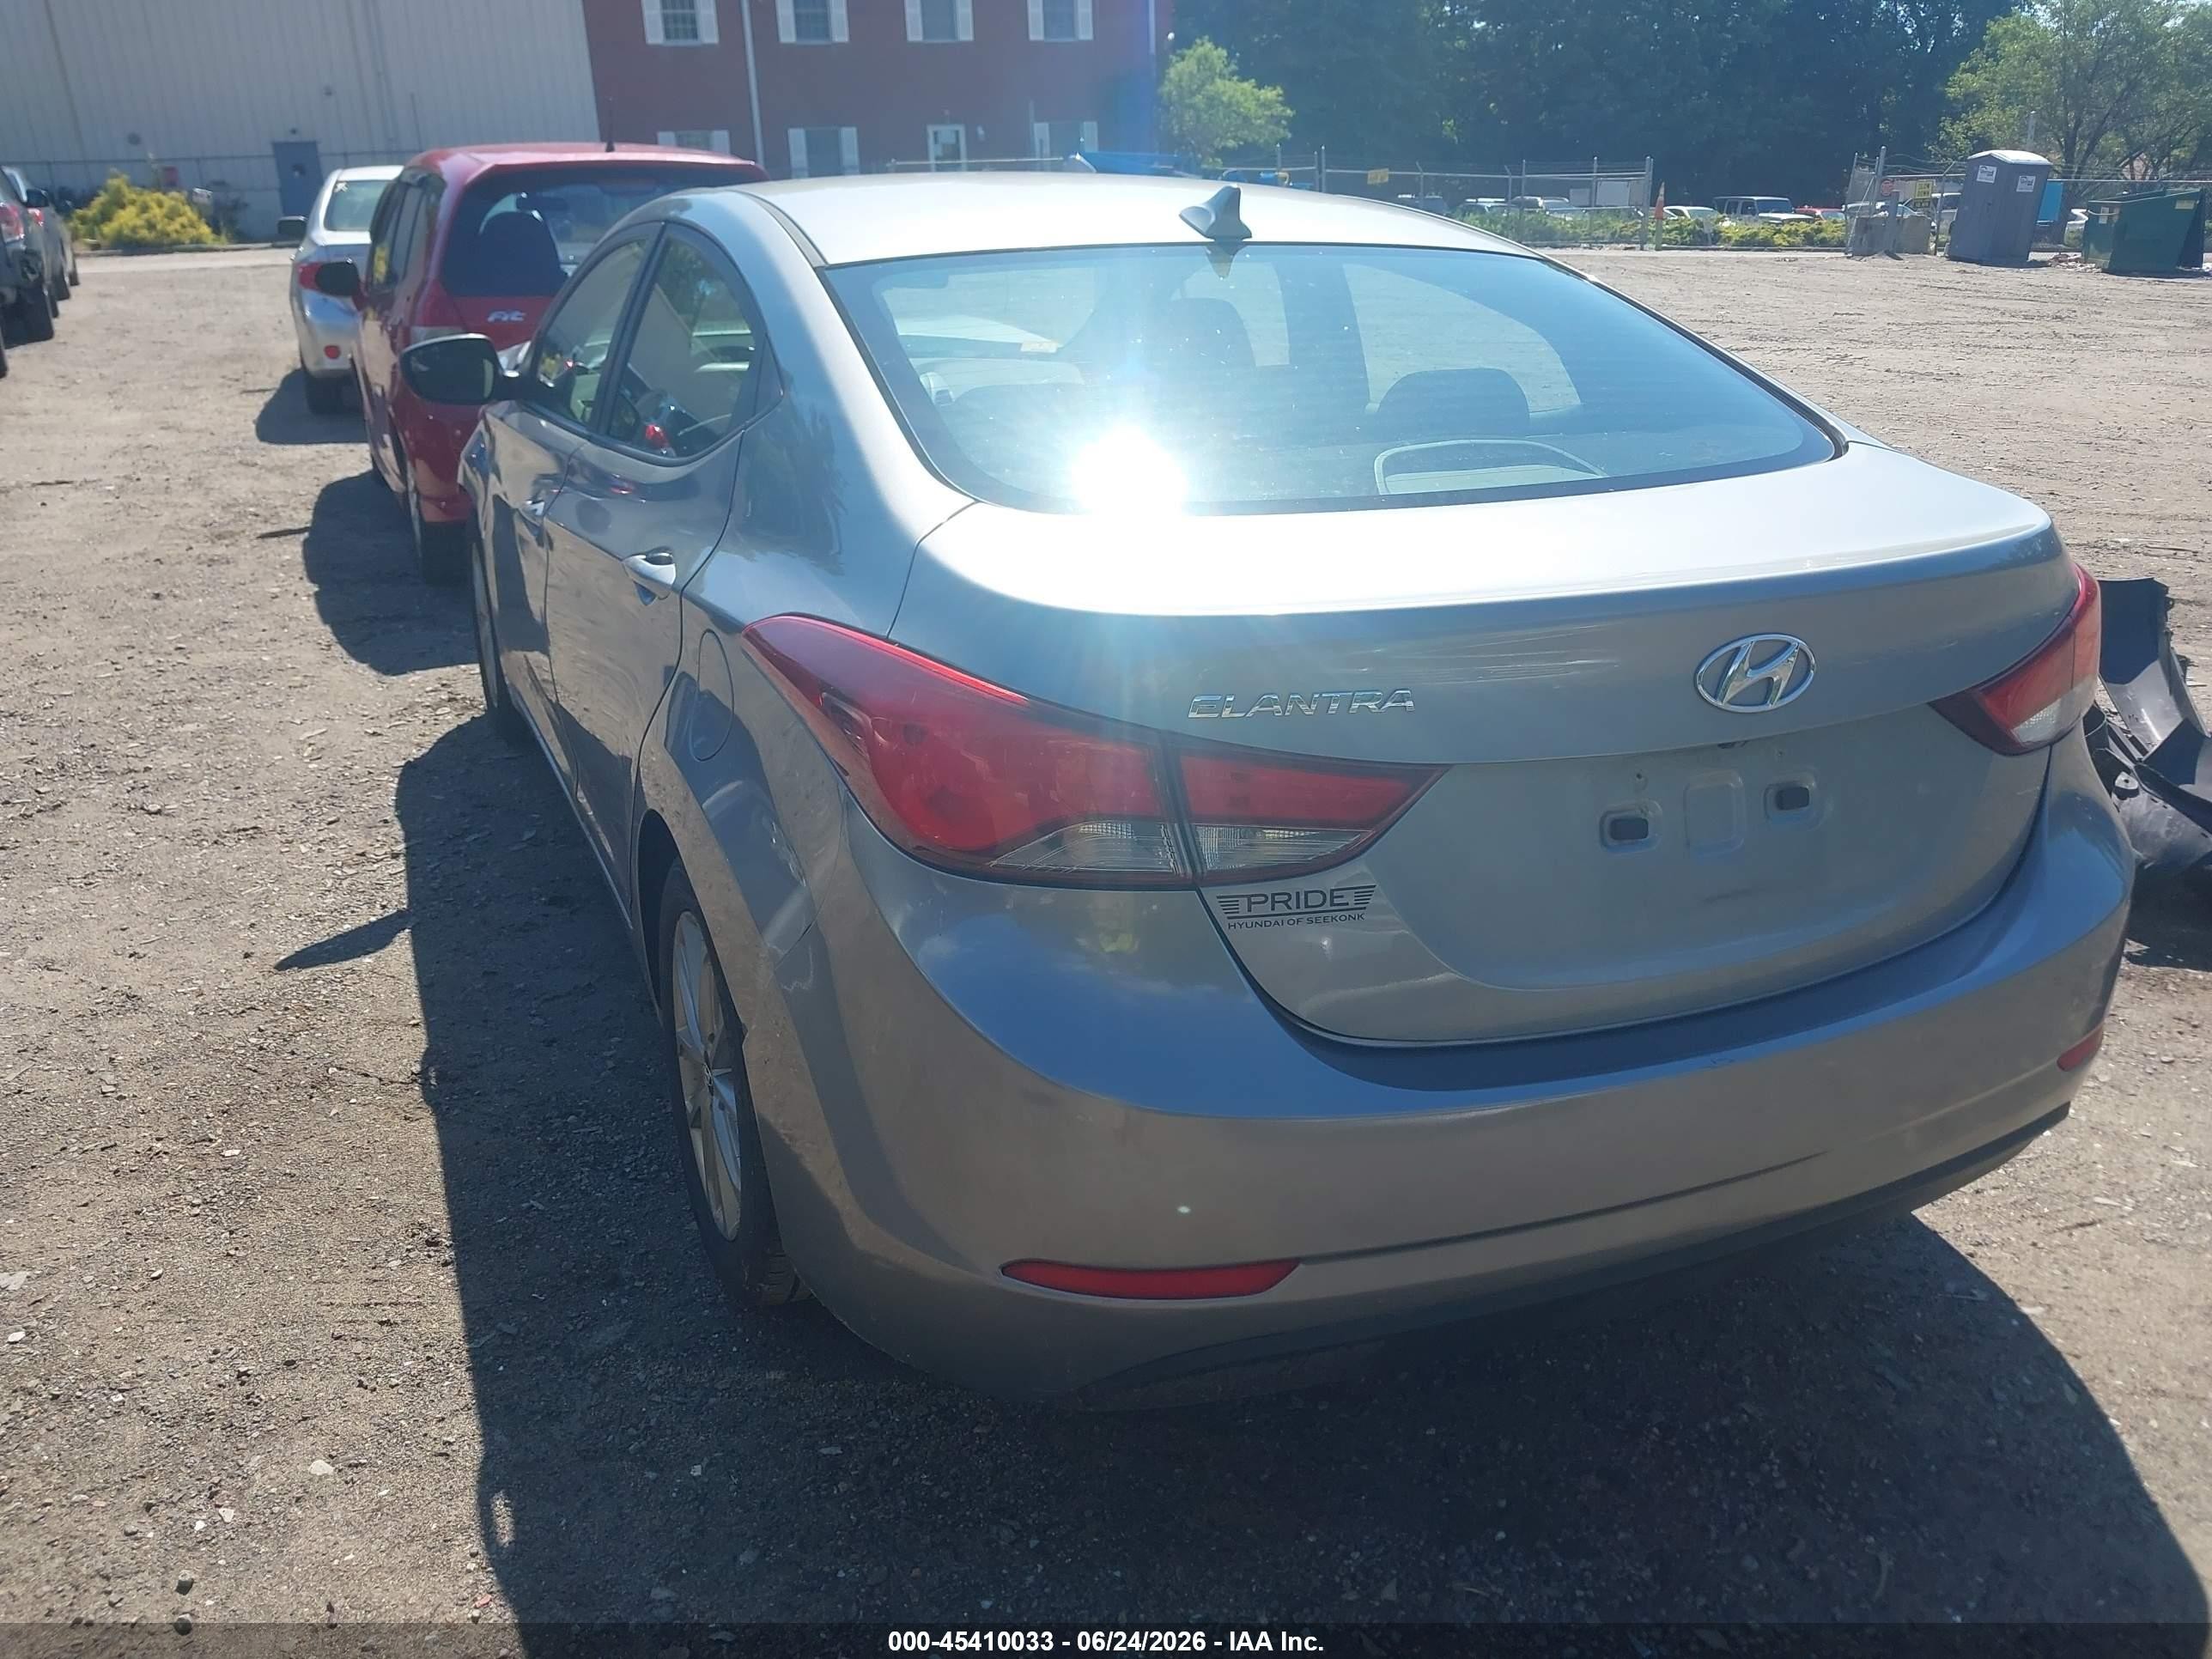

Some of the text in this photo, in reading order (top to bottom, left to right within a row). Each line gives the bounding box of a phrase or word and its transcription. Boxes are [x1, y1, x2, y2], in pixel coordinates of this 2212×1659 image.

[1188, 688, 1416, 719] ELANTRA
[1246, 889, 1350, 913] PRIDE
[1228, 913, 1365, 930] HYUNDAI OF SEEKONK
